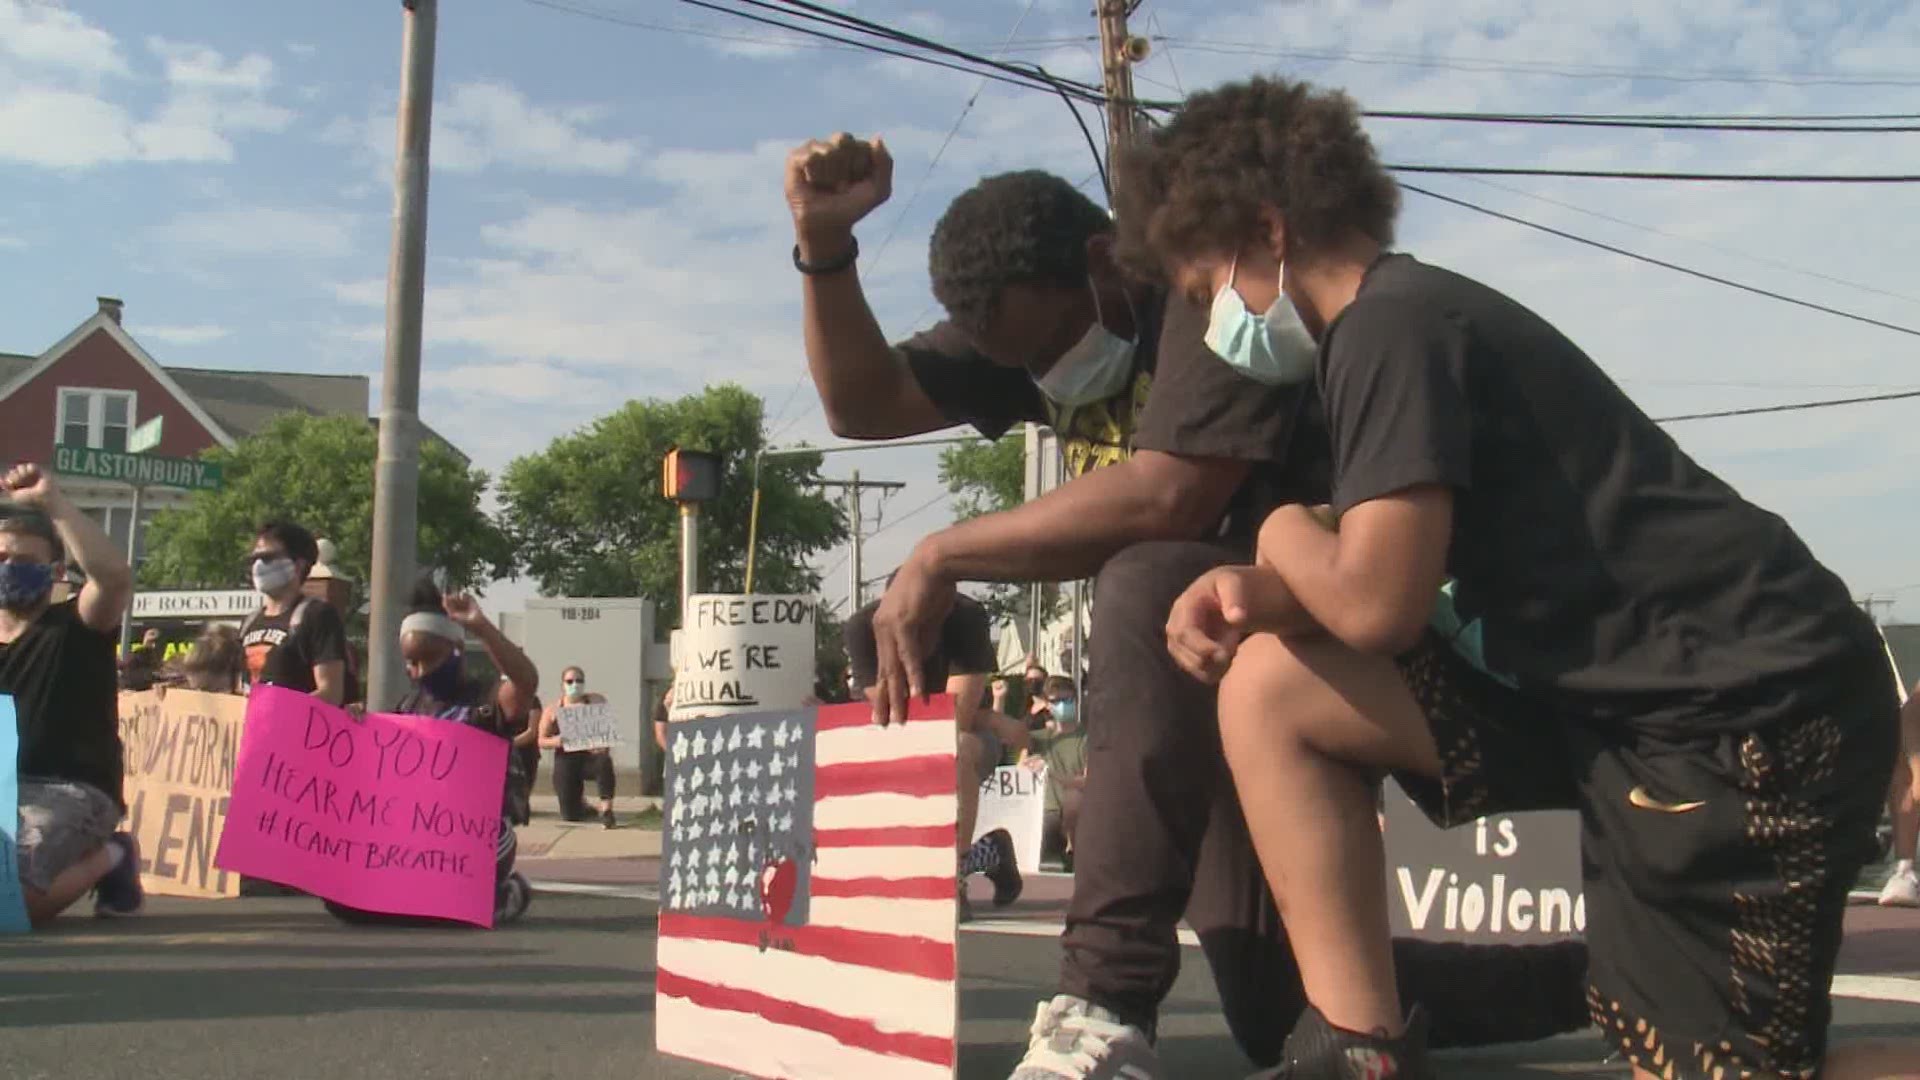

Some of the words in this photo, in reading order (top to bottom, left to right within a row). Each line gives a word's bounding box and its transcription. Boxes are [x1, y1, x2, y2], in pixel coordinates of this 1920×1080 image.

[56, 447, 206, 486] GLASTONBURY
[159, 596, 219, 610] ROCKY
[698, 599, 815, 629] FREEDOM
[677, 681, 753, 704] EQUAL
[303, 707, 355, 768] DO
[372, 728, 459, 781] YOU
[261, 753, 344, 823] HEAR
[347, 789, 395, 827] ME
[1475, 816, 1518, 857] is
[366, 842, 474, 878] BREATHE
